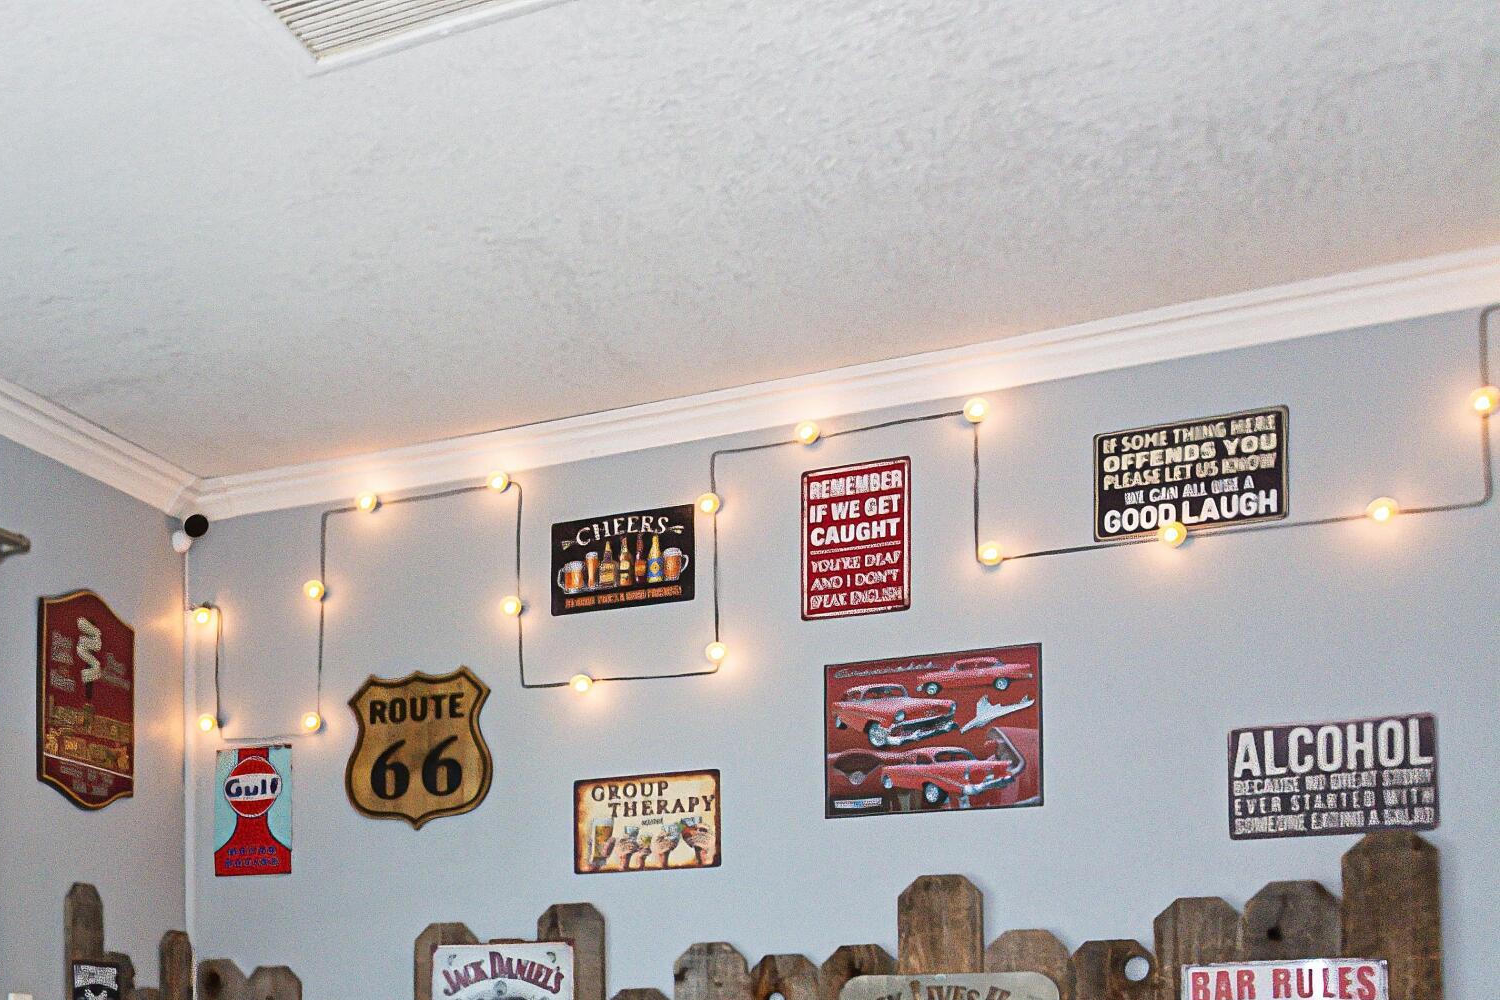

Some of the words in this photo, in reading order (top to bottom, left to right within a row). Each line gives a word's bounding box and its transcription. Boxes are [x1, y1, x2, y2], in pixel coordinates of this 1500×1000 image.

[1103, 439, 1117, 454] IF
[1103, 441, 1217, 473] OFFENDS
[1223, 433, 1277, 456] YOU
[809, 469, 903, 500] REMEMBER
[1103, 468, 1161, 491] PLEASE
[1165, 464, 1193, 482] LET
[1195, 460, 1219, 478] US
[1221, 452, 1277, 474] KNOW
[1149, 486, 1179, 502] CAN
[1182, 482, 1208, 498] ALL
[1243, 475, 1255, 490] A
[809, 504, 828, 524] IF
[831, 499, 861, 521] WE
[864, 494, 901, 516] GET
[1103, 503, 1177, 534] GOOD
[1181, 489, 1278, 525] LAUGH
[576, 516, 669, 546] CHEERS
[810, 518, 901, 547] CAUGHT
[864, 550, 902, 567] DEAF
[810, 576, 843, 592] AND
[846, 574, 851, 588] I
[370, 692, 465, 725] ROUTE
[1233, 718, 1434, 778] ALCOHOL
[370, 735, 463, 800] 66
[225, 777, 280, 798] Gulf
[591, 780, 669, 801] GROUP
[1233, 776, 1301, 797] BECAUSE
[1233, 797, 1282, 817] EVER
[1290, 790, 1377, 812] STARTED
[1382, 786, 1435, 805] WITH
[608, 794, 715, 818] THERAPY
[1233, 813, 1307, 835] SOMEONE
[1368, 809, 1379, 825] A
[442, 958, 490, 996] JACK
